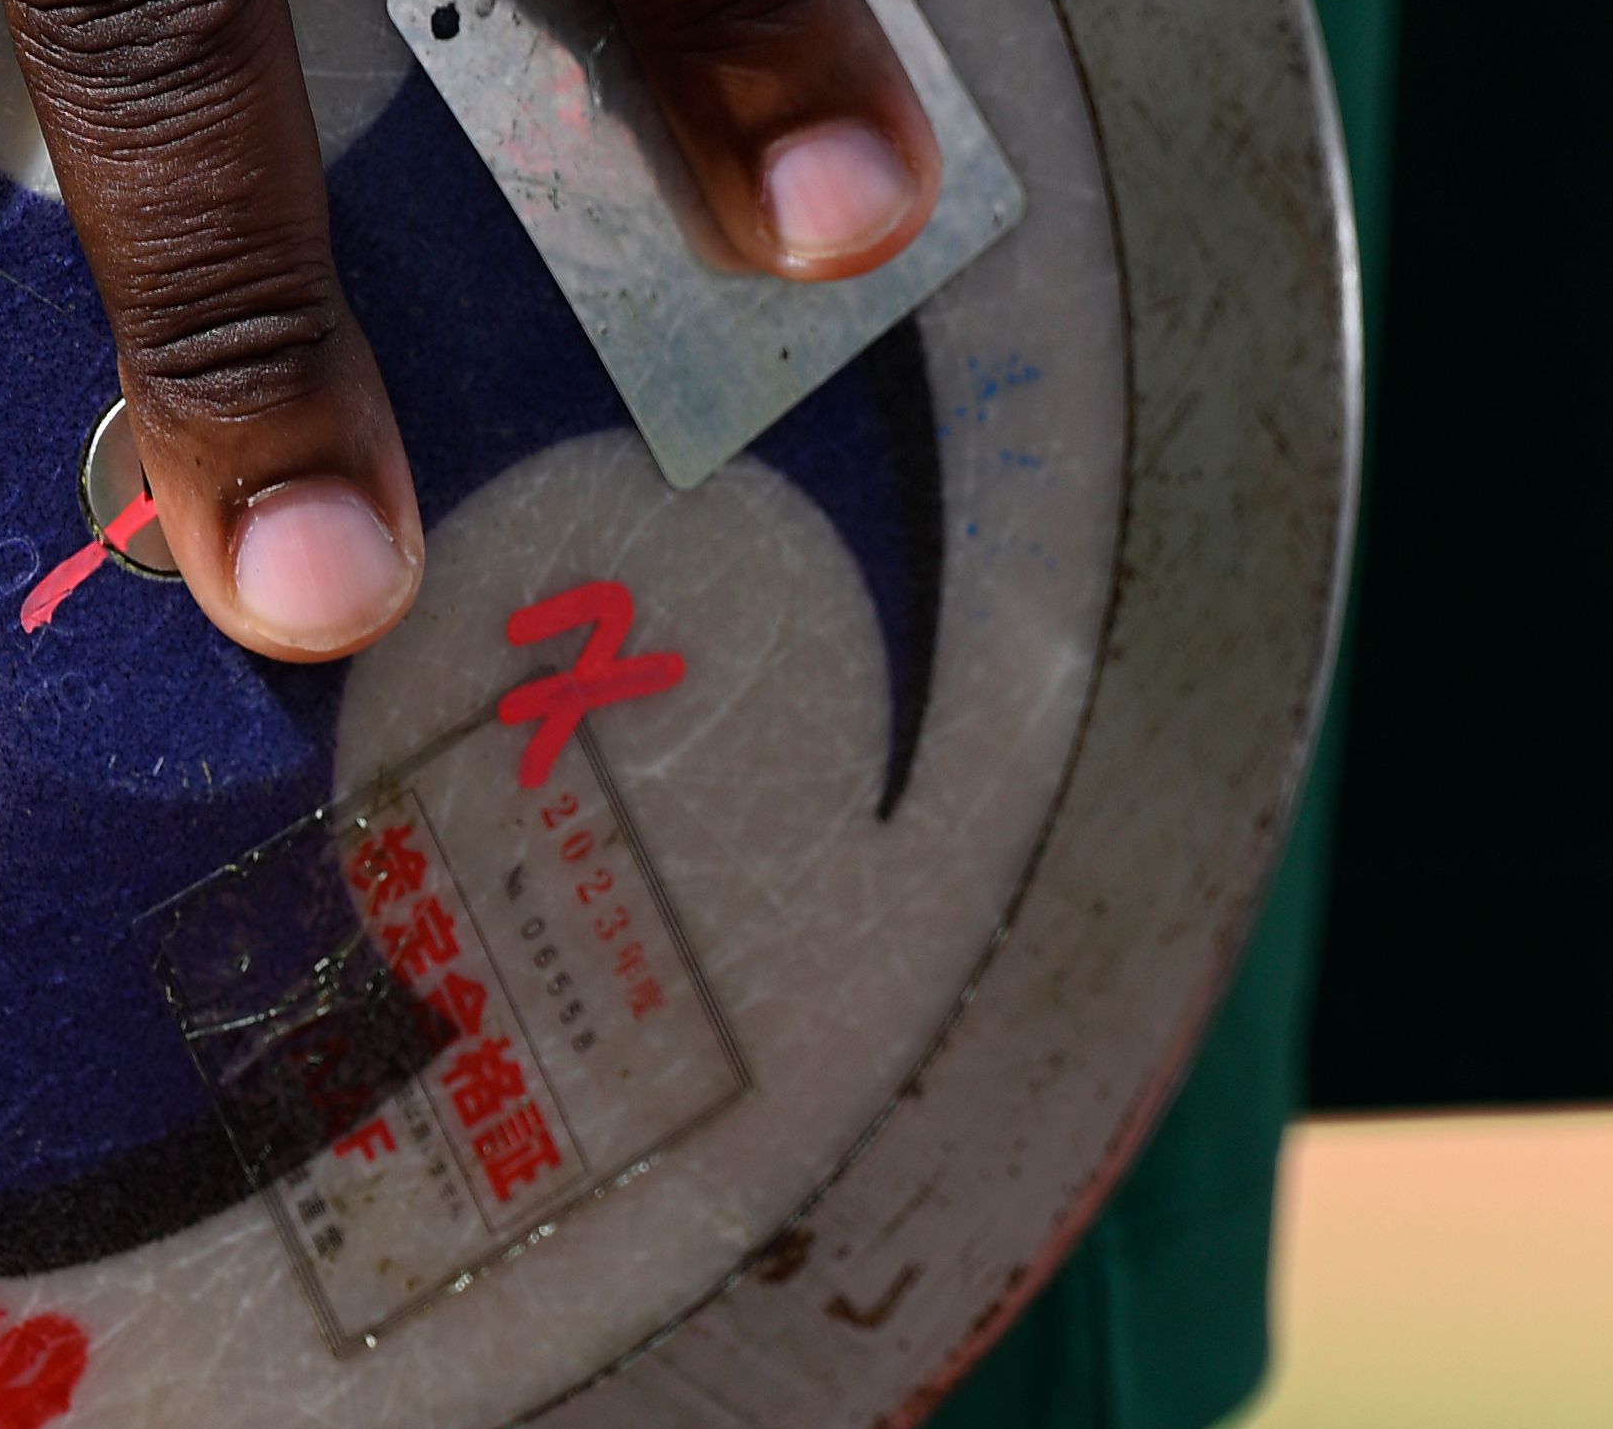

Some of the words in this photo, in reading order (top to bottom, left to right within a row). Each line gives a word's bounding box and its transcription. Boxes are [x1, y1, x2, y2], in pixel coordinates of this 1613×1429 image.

[344, 822, 562, 1204] 検定合格証
[541, 791, 665, 1020] 2023年度
